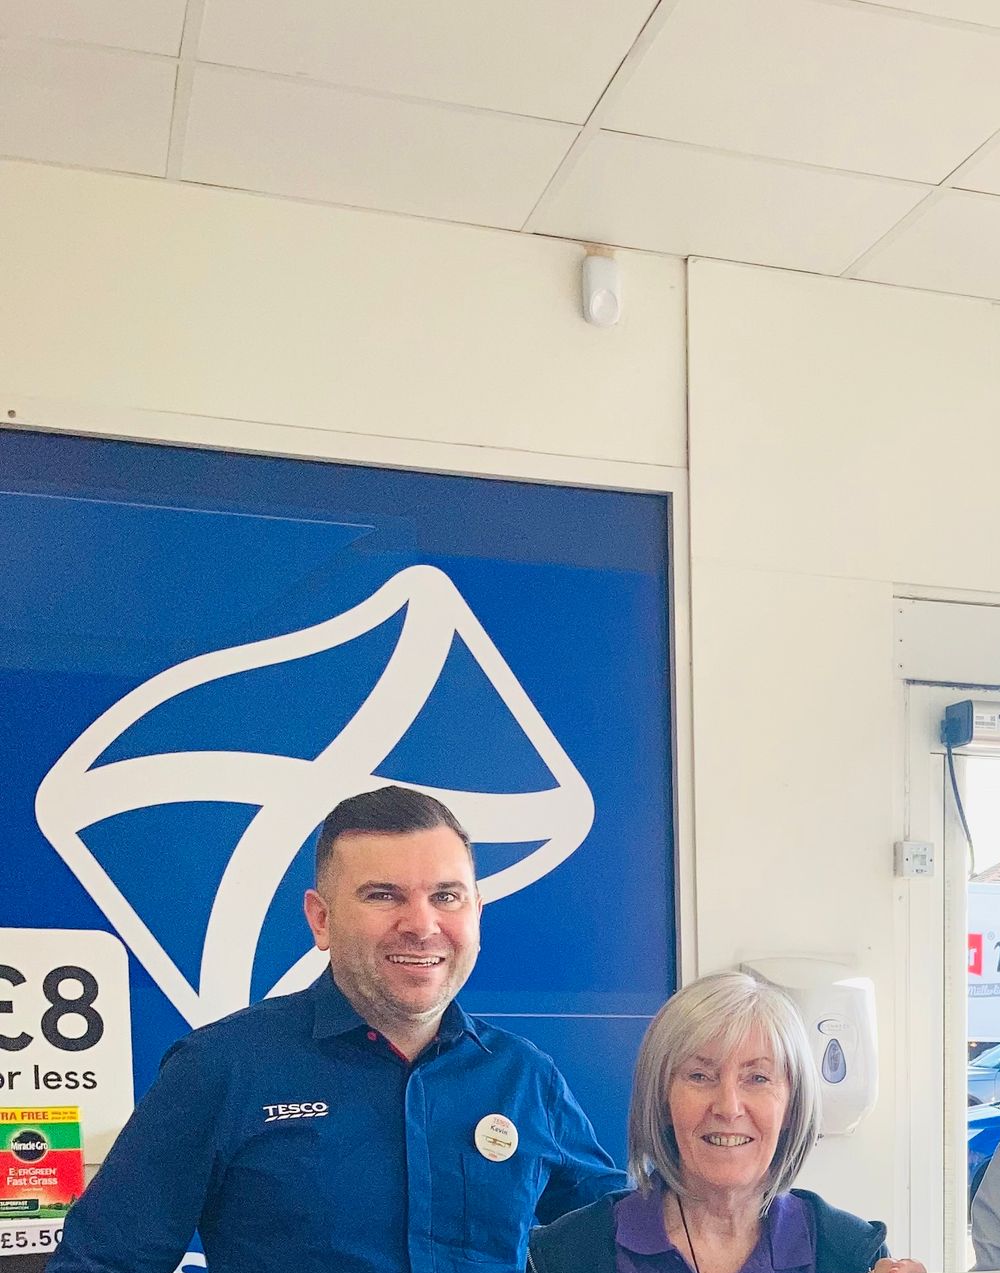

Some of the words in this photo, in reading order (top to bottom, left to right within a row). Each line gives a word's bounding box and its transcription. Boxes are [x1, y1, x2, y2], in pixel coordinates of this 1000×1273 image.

[34, 1065, 98, 1090] less
[20, 1111, 49, 1120] FREE
[263, 1102, 328, 1118] TESCO
[6, 1176, 28, 1186] Fast
[29, 1175, 58, 1185] Grass
